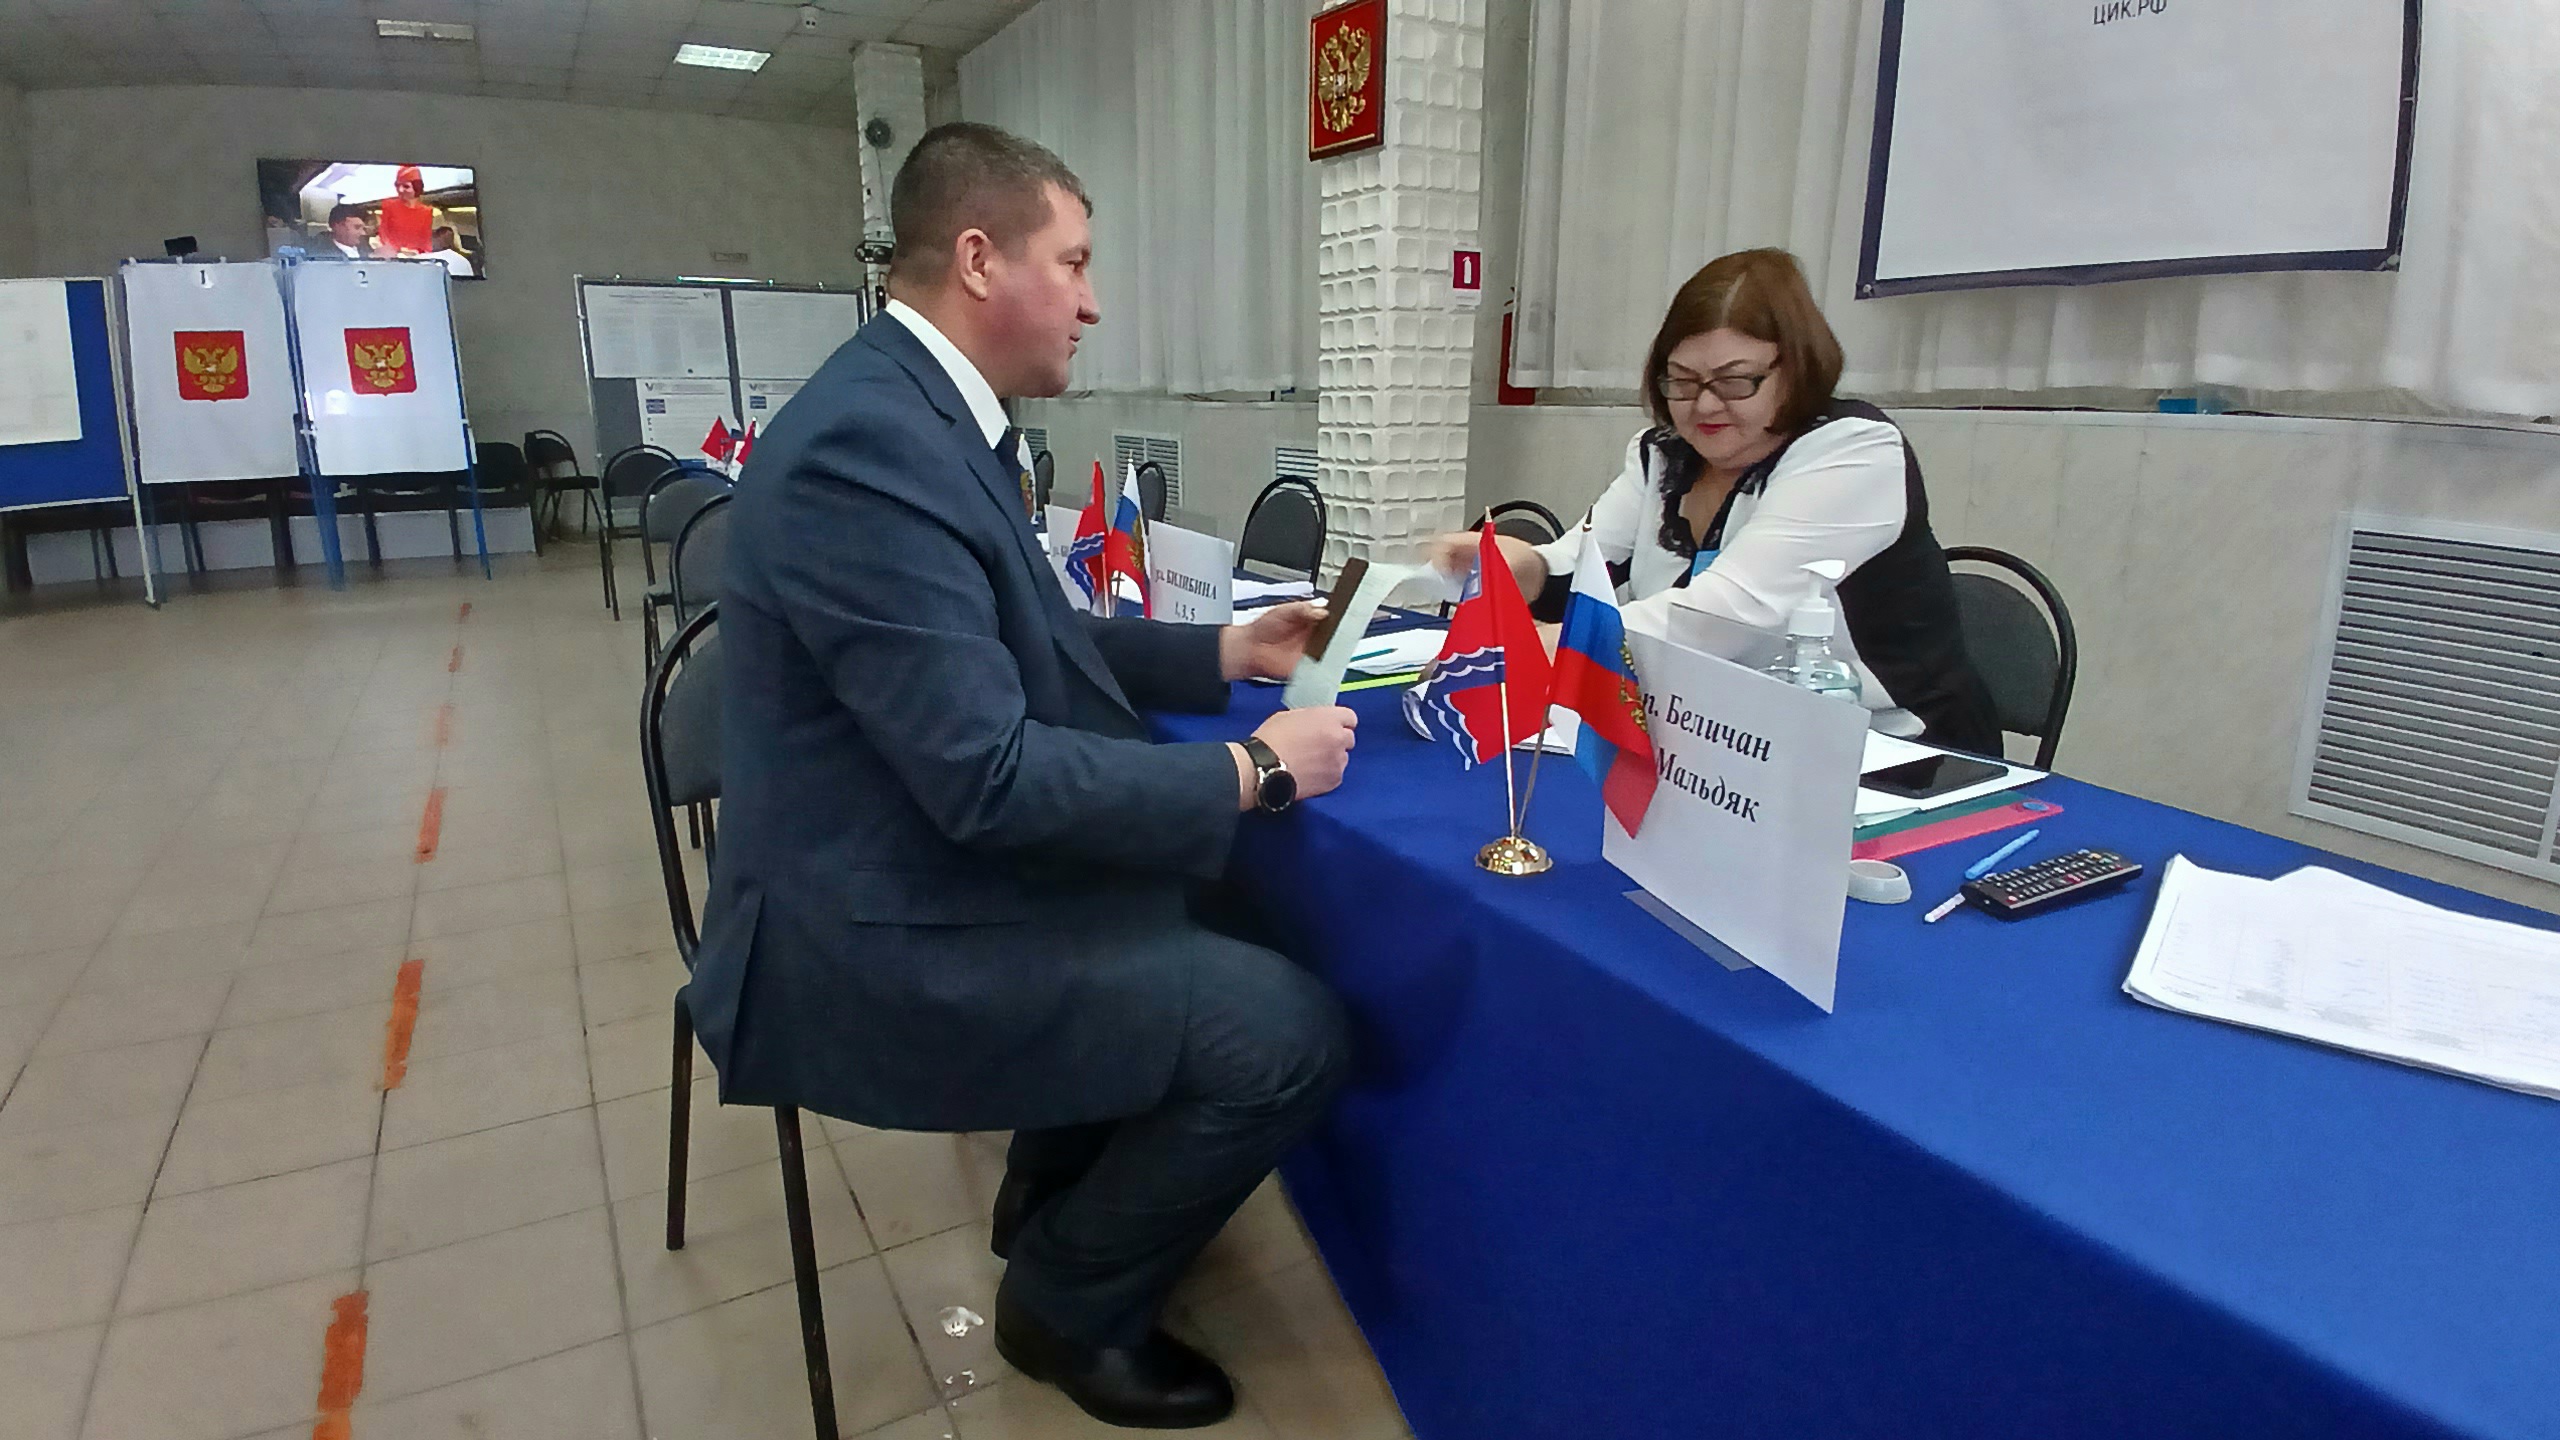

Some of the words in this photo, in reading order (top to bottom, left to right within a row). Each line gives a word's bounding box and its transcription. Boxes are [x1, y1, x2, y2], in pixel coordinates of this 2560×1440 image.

[2093, 0, 2167, 26] ЦИК.РФ
[1666, 694, 1771, 762] Беличан
[1656, 747, 1760, 823] Мальдяк
